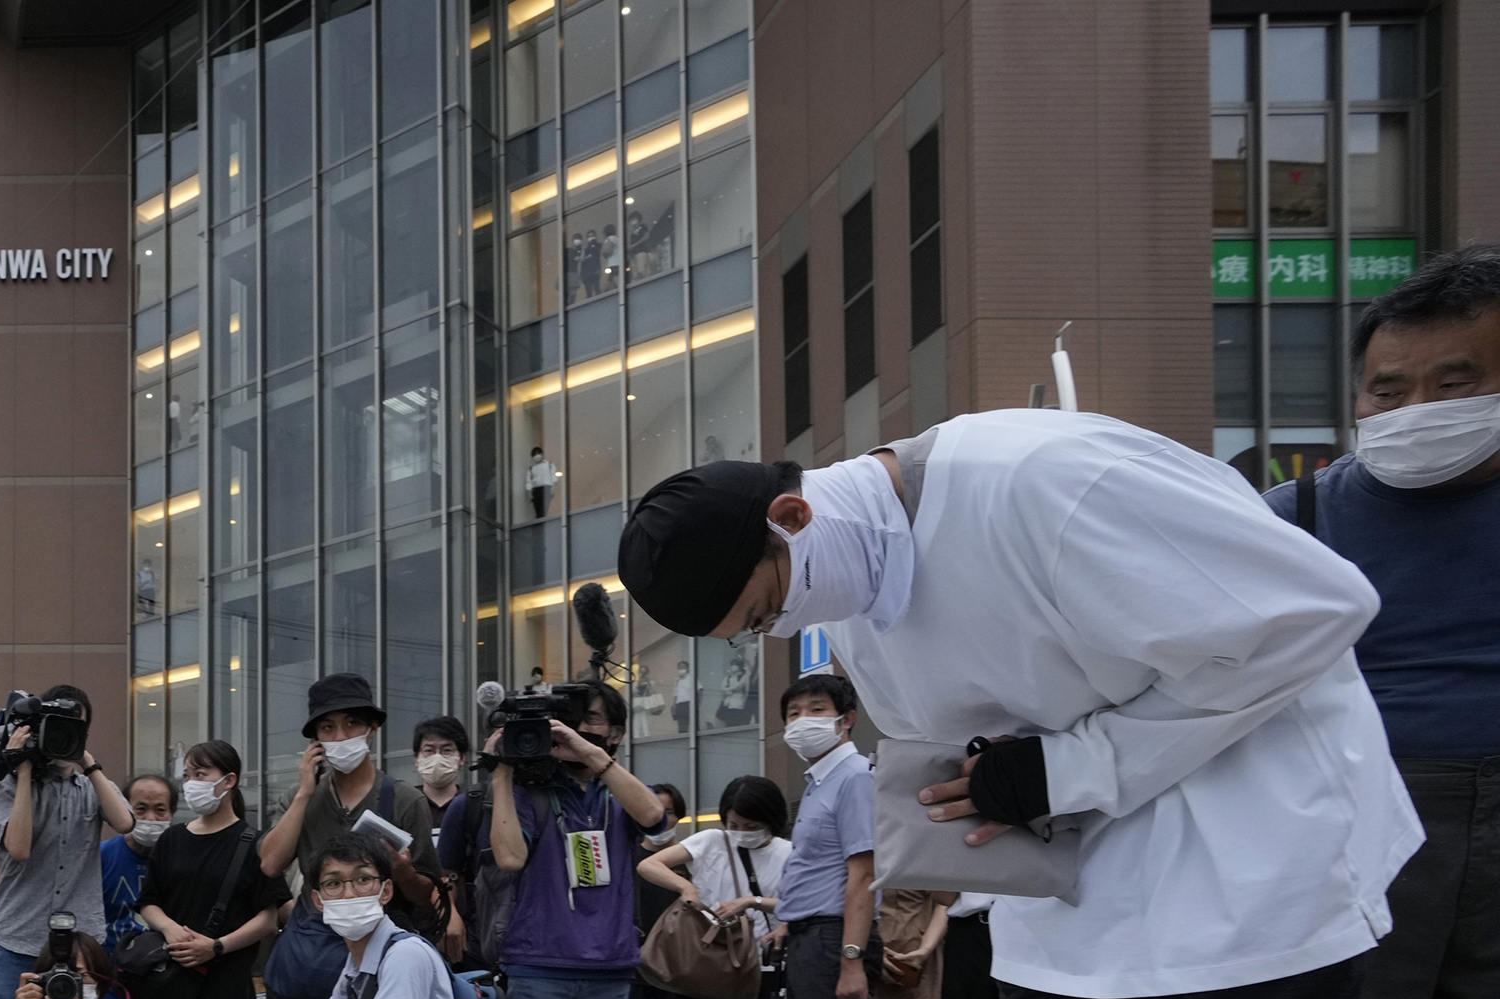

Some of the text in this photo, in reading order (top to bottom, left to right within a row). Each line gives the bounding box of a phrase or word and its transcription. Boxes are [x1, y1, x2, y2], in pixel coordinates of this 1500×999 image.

[56, 248, 113, 280] CITY
[1211, 254, 1329, 283] 療内科
